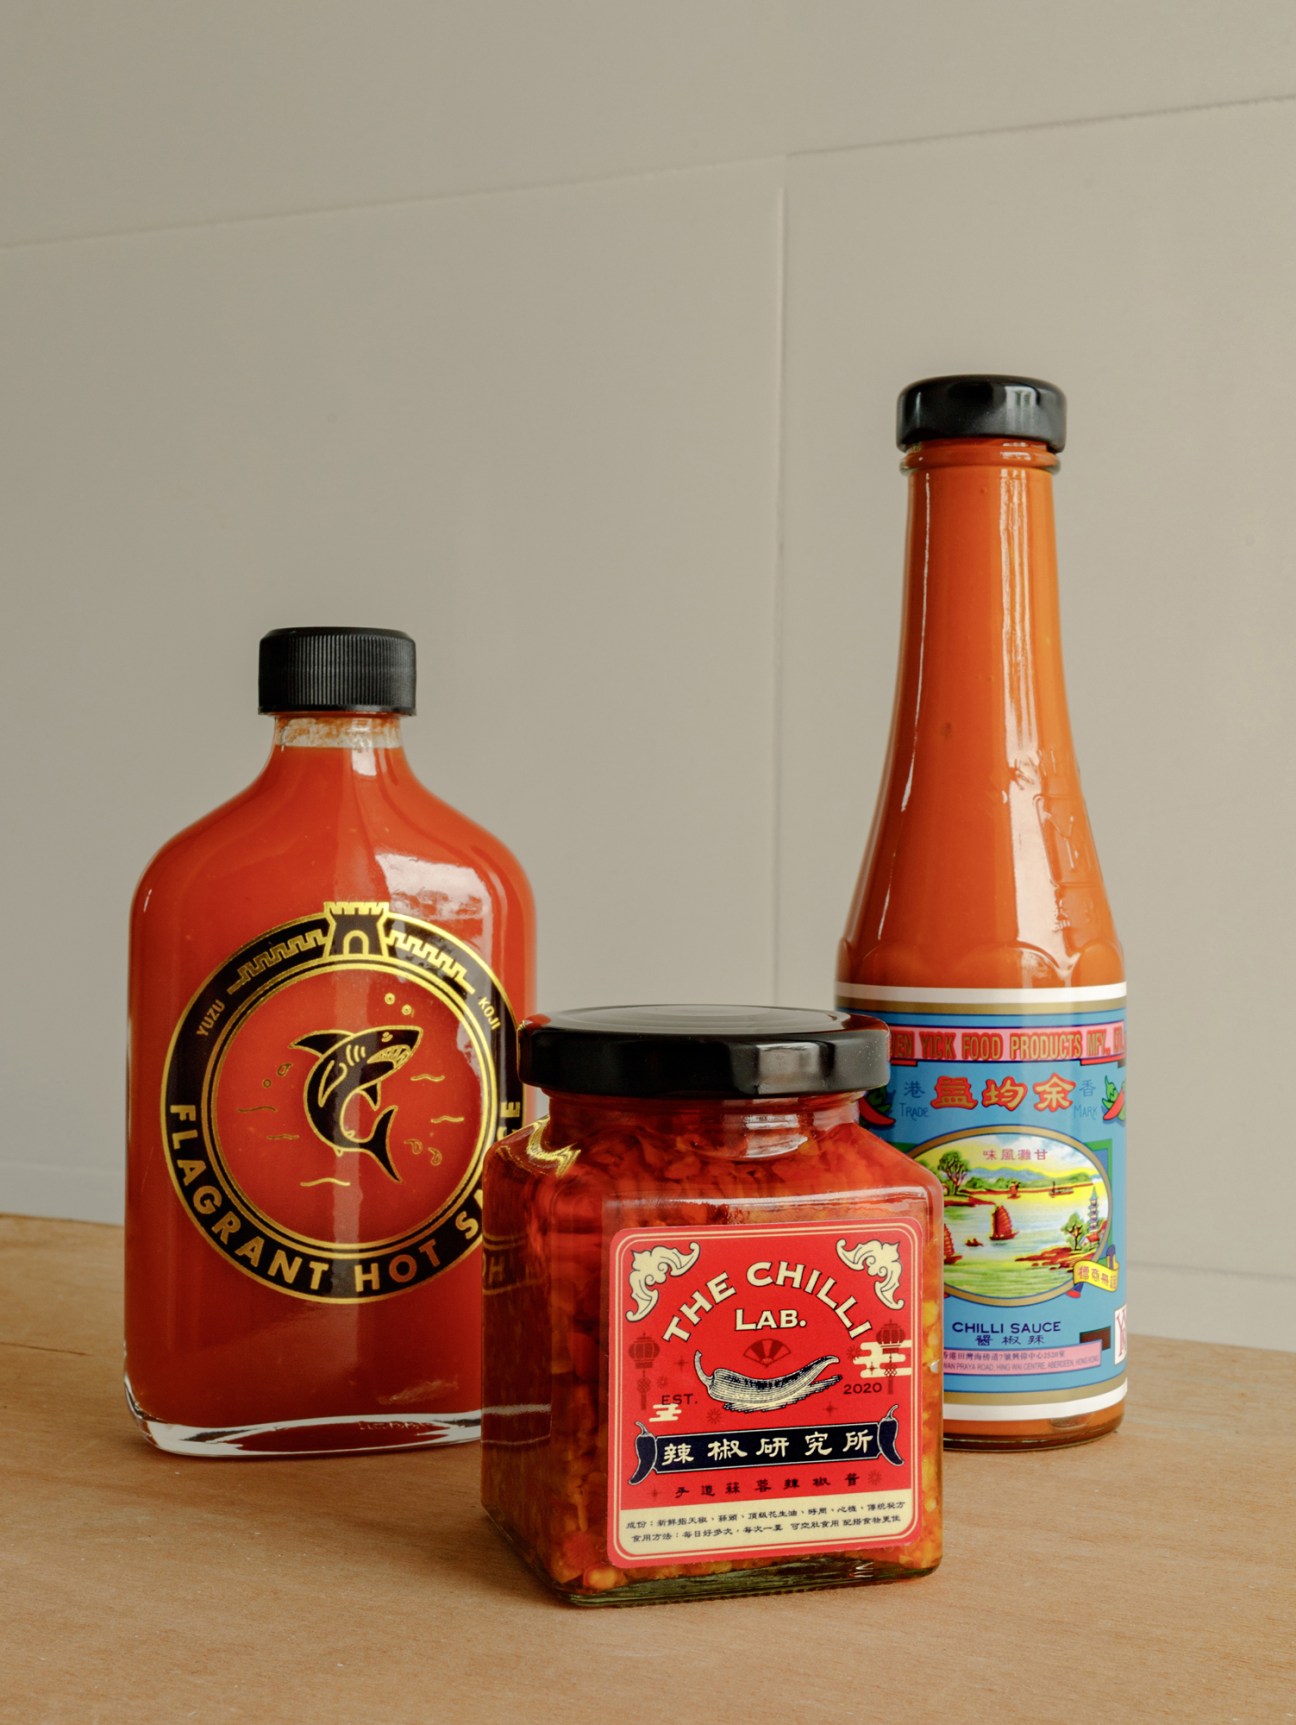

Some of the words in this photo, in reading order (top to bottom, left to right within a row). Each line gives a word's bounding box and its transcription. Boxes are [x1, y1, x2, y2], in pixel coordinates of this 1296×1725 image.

[196, 999, 225, 1038] YUZU
[477, 995, 500, 1031] KOJI
[919, 1032, 957, 1060] YICK
[961, 1031, 1003, 1060] FOOD
[1009, 1030, 1083, 1060] PRODUCTS
[904, 1081, 925, 1099] 港
[1079, 1080, 1096, 1097] 香
[900, 1103, 929, 1120] TRADE
[1073, 1104, 1098, 1120] MARK
[169, 1104, 329, 1290] FLAGRANT
[354, 1240, 441, 1292] HOT
[662, 1272, 736, 1342] THE
[746, 1261, 873, 1339] CHILLI
[735, 1309, 807, 1331] LAB.
[952, 1321, 1004, 1334] CHILLI
[1010, 1321, 1061, 1333] SAUCE
[957, 1362, 976, 1370] PRAYA
[843, 1382, 882, 1395] 2020
[661, 1393, 698, 1405] EST.
[662, 1429, 874, 1466] 辣椒研究所
